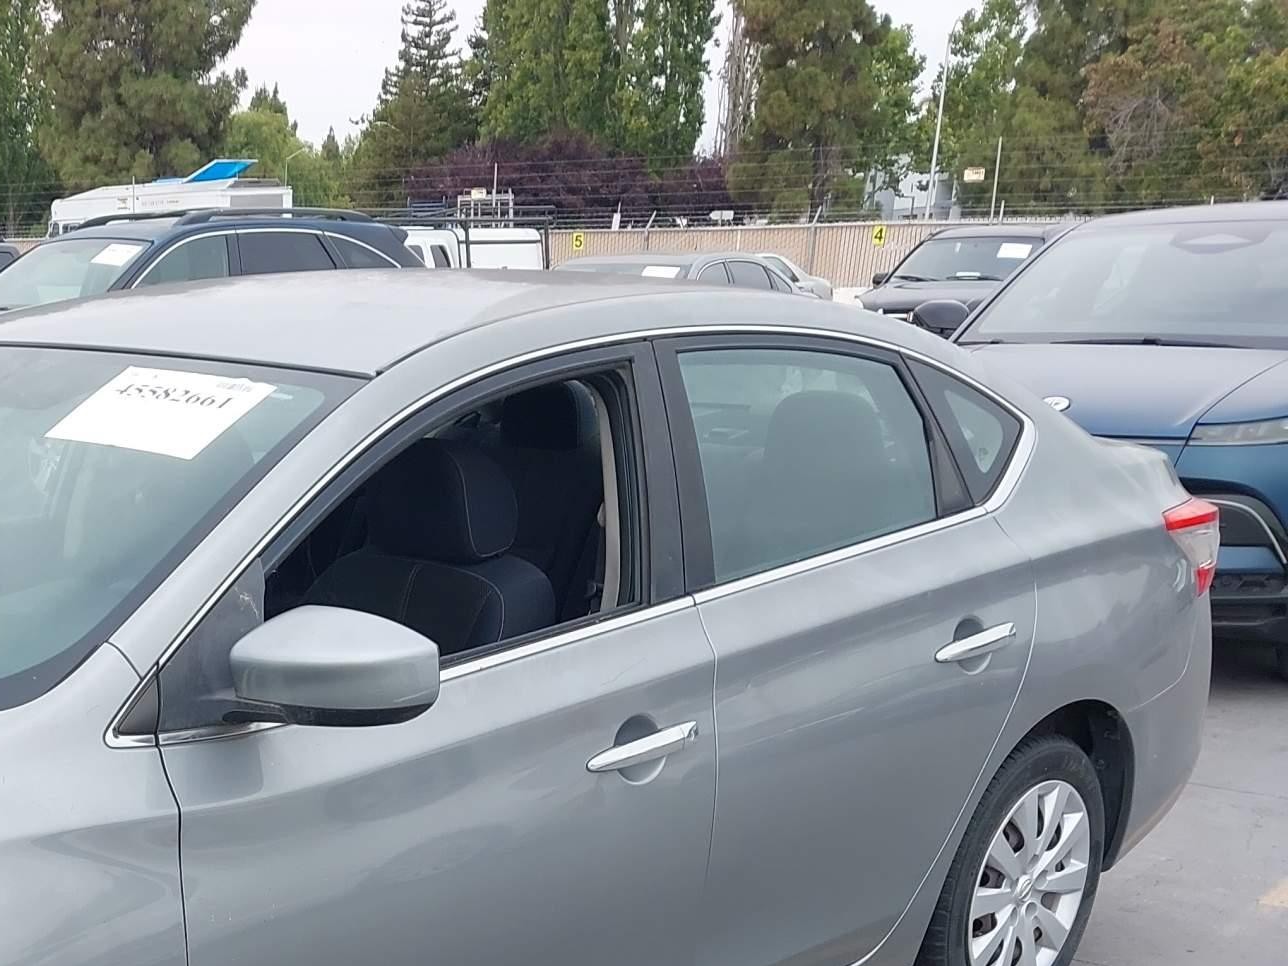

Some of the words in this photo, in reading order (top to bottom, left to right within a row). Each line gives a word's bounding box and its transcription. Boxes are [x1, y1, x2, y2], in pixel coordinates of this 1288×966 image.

[574, 234, 583, 248] 5
[874, 227, 883, 242] 4
[115, 384, 232, 408] 45582661
